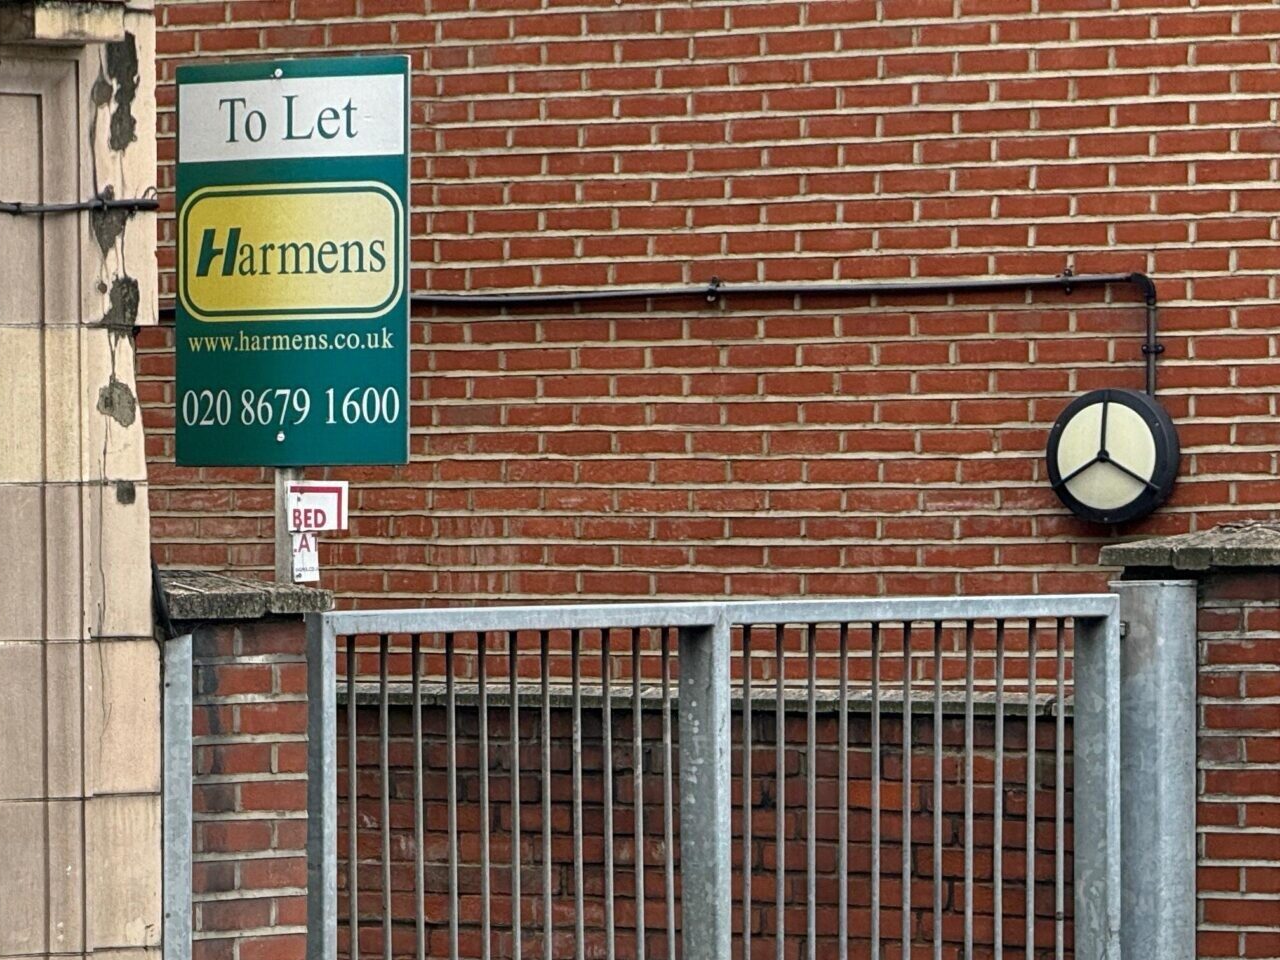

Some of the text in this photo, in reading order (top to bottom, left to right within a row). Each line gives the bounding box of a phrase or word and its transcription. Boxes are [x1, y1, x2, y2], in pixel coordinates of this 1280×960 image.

[219, 94, 358, 143] To Let
[196, 227, 386, 277] Harmens
[188, 327, 394, 352] www.harmens.co.uk
[182, 386, 400, 426] 020 8679 1600
[292, 508, 327, 528] BED
